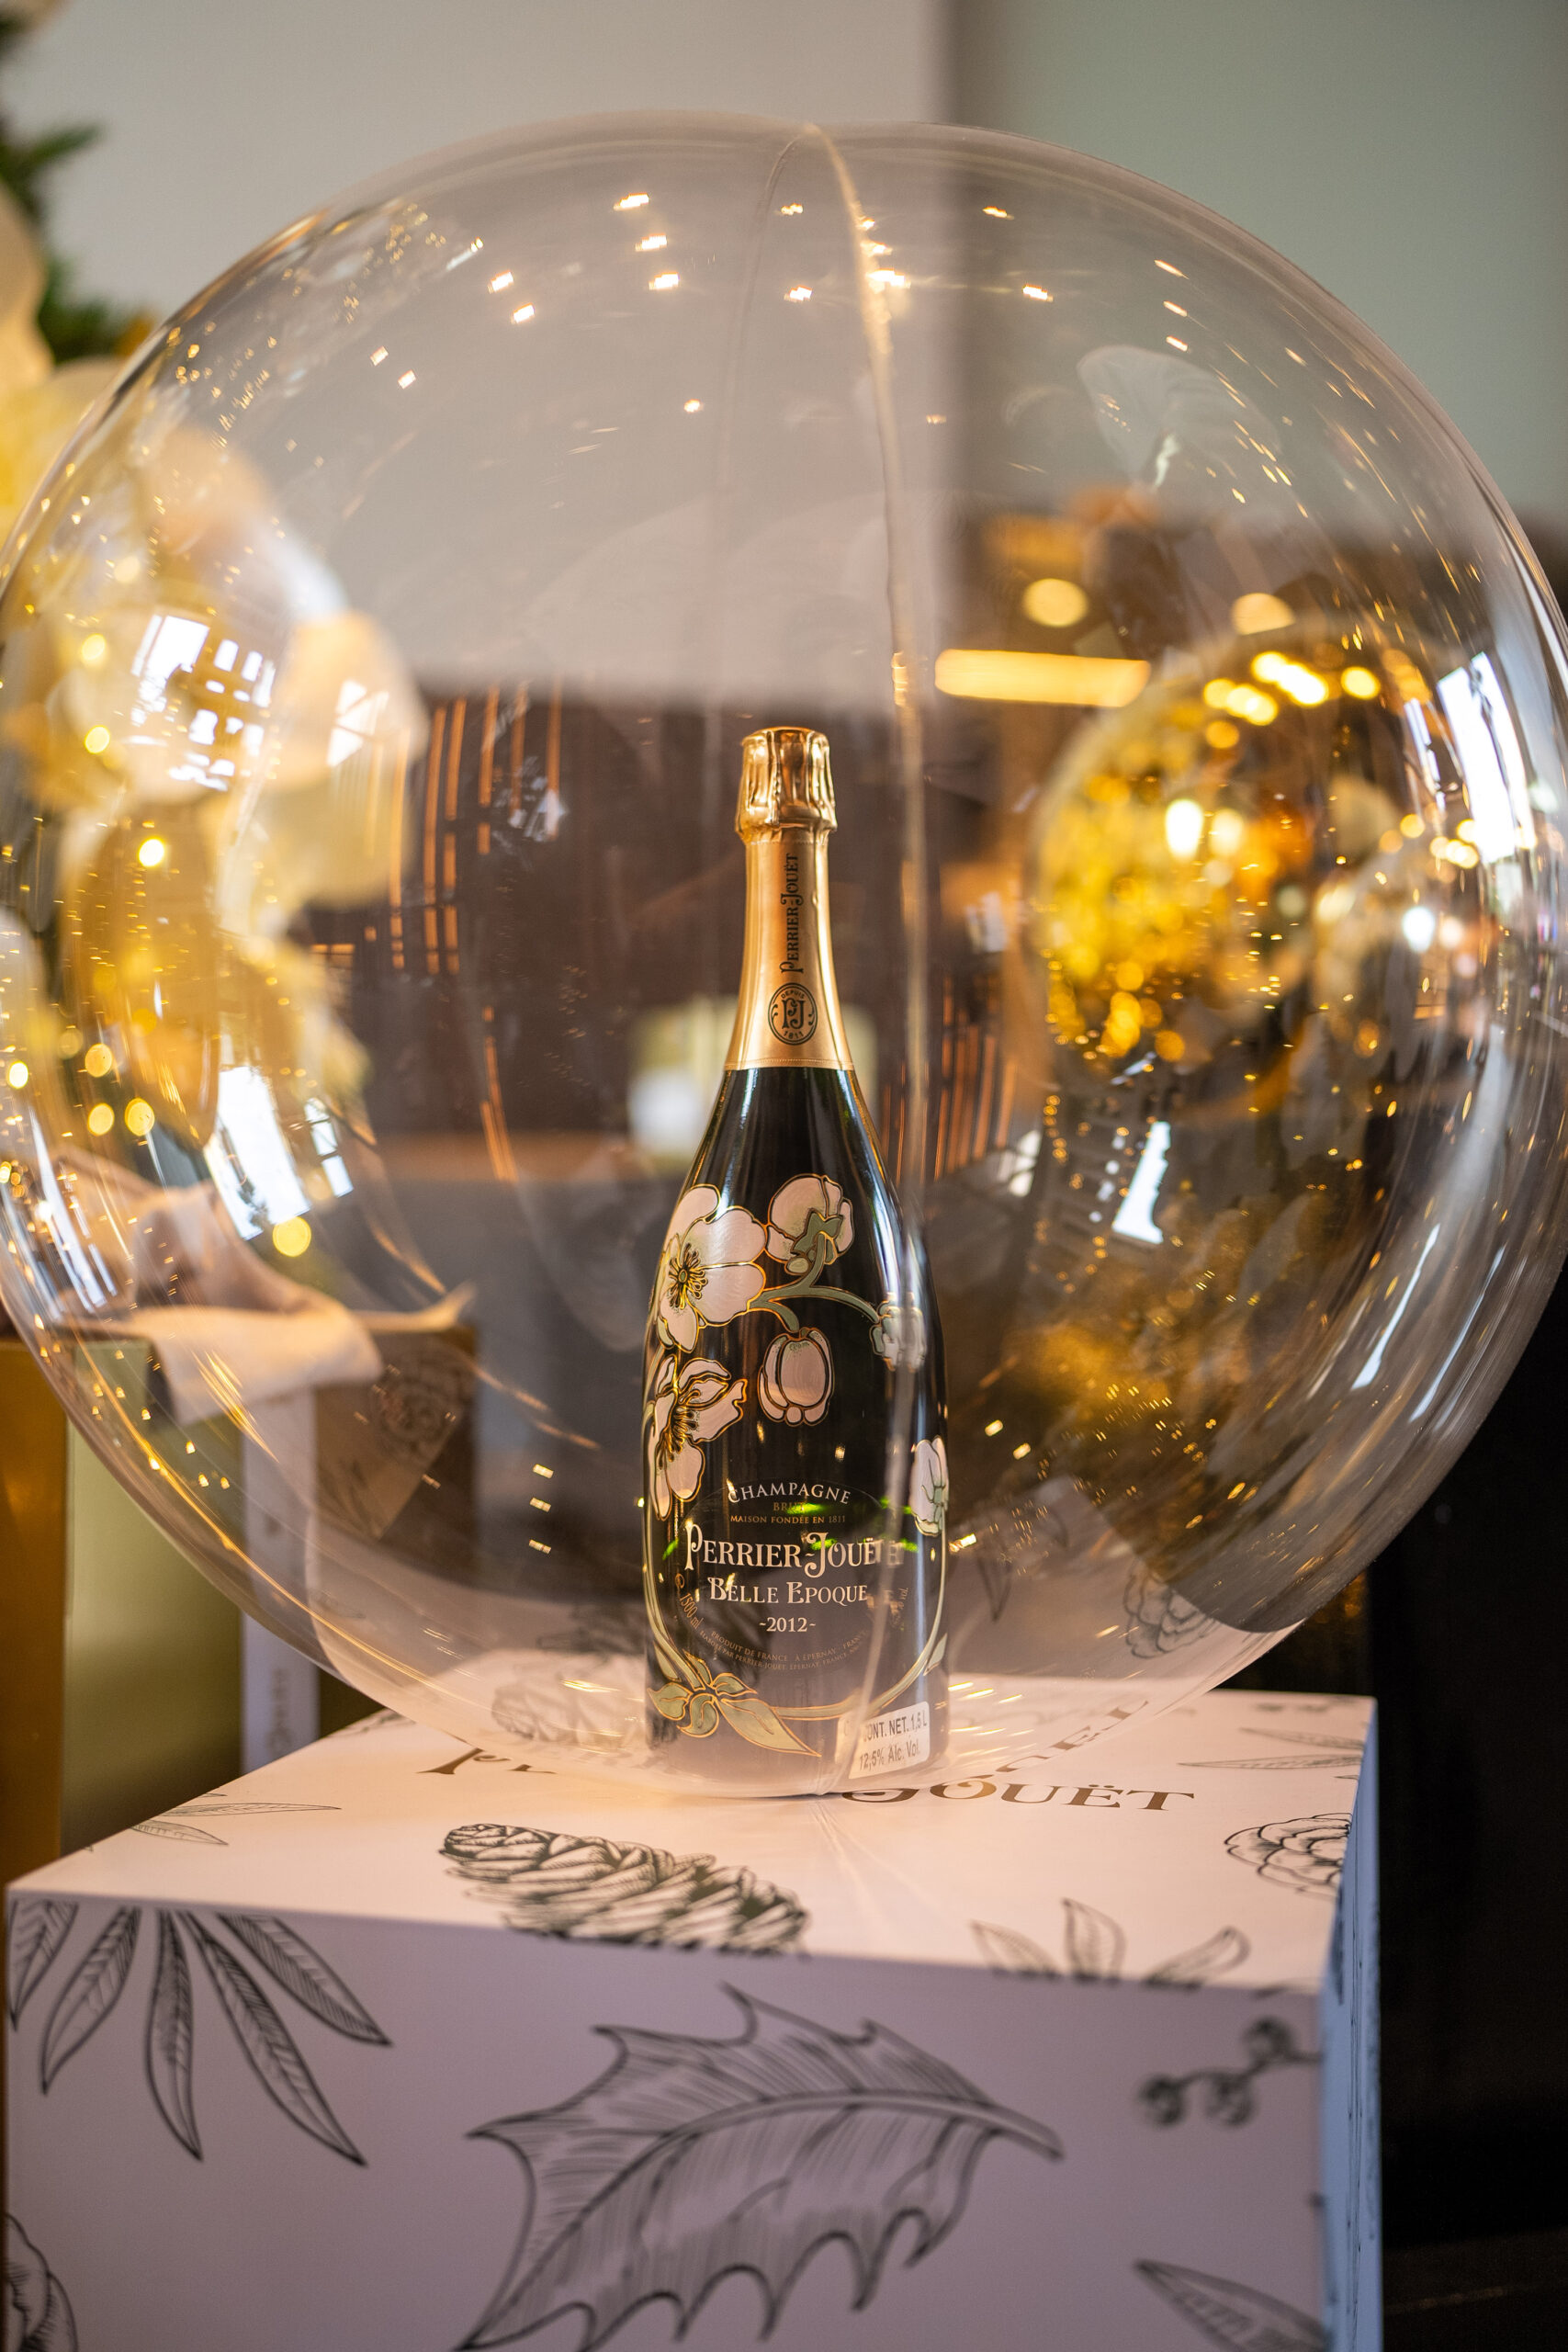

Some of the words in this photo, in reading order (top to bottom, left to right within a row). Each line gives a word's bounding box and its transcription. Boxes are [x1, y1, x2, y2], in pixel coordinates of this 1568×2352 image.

[728, 1482, 852, 1505] CHAMPAGNE
[730, 1515, 767, 1523] MAISON
[813, 1516, 825, 1524] EN
[829, 1515, 846, 1523] 1811
[707, 1577, 779, 1604] BELLE
[786, 1581, 867, 1607] EPOQUE
[680, 1592, 698, 1618] 1500
[690, 1617, 705, 1630] ml
[711, 1631, 743, 1652] PRODUIT
[744, 1647, 755, 1656] DE
[863, 1722, 887, 1743] ONT.
[888, 1716, 909, 1736] NET.
[860, 1748, 885, 1770] 12,5%
[887, 1743, 905, 1762] Alc.
